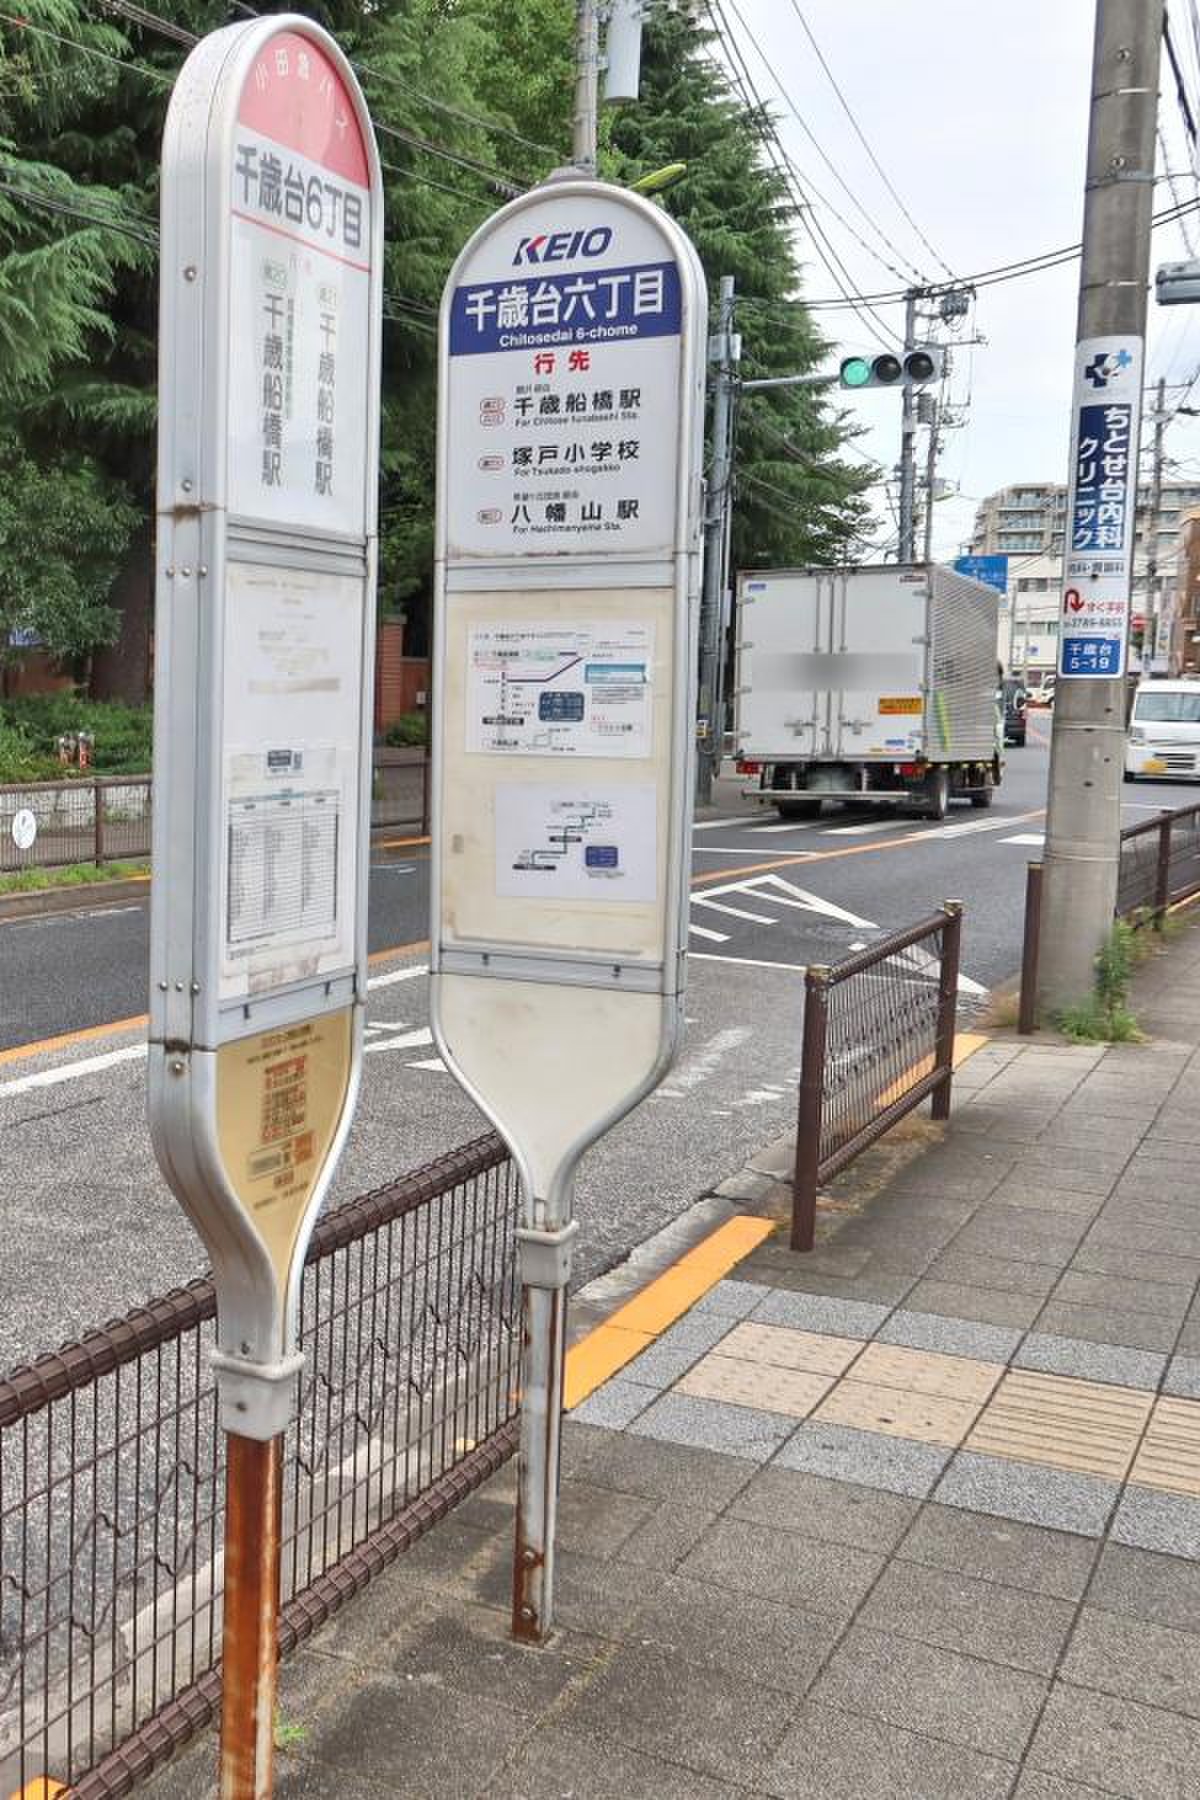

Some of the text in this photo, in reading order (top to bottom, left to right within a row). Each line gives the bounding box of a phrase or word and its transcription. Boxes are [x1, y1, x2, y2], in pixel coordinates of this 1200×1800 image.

[235, 144, 362, 249] 千歳台6丁目
[512, 226, 613, 266] KEIO
[465, 269, 663, 333] 千歳台六丁目
[499, 328, 573, 348] Chitosedai
[261, 293, 285, 488] 千歳船橋駅
[513, 388, 641, 417] 千歳船橋駅
[512, 440, 640, 466] 塚戸小学校
[1073, 436, 1099, 549] クリニック
[1095, 406, 1131, 549] ちとせ台内科
[511, 499, 640, 525] 八幡山駅
[1069, 642, 1113, 657] 千歳台
[1071, 656, 1110, 670] 5-19
